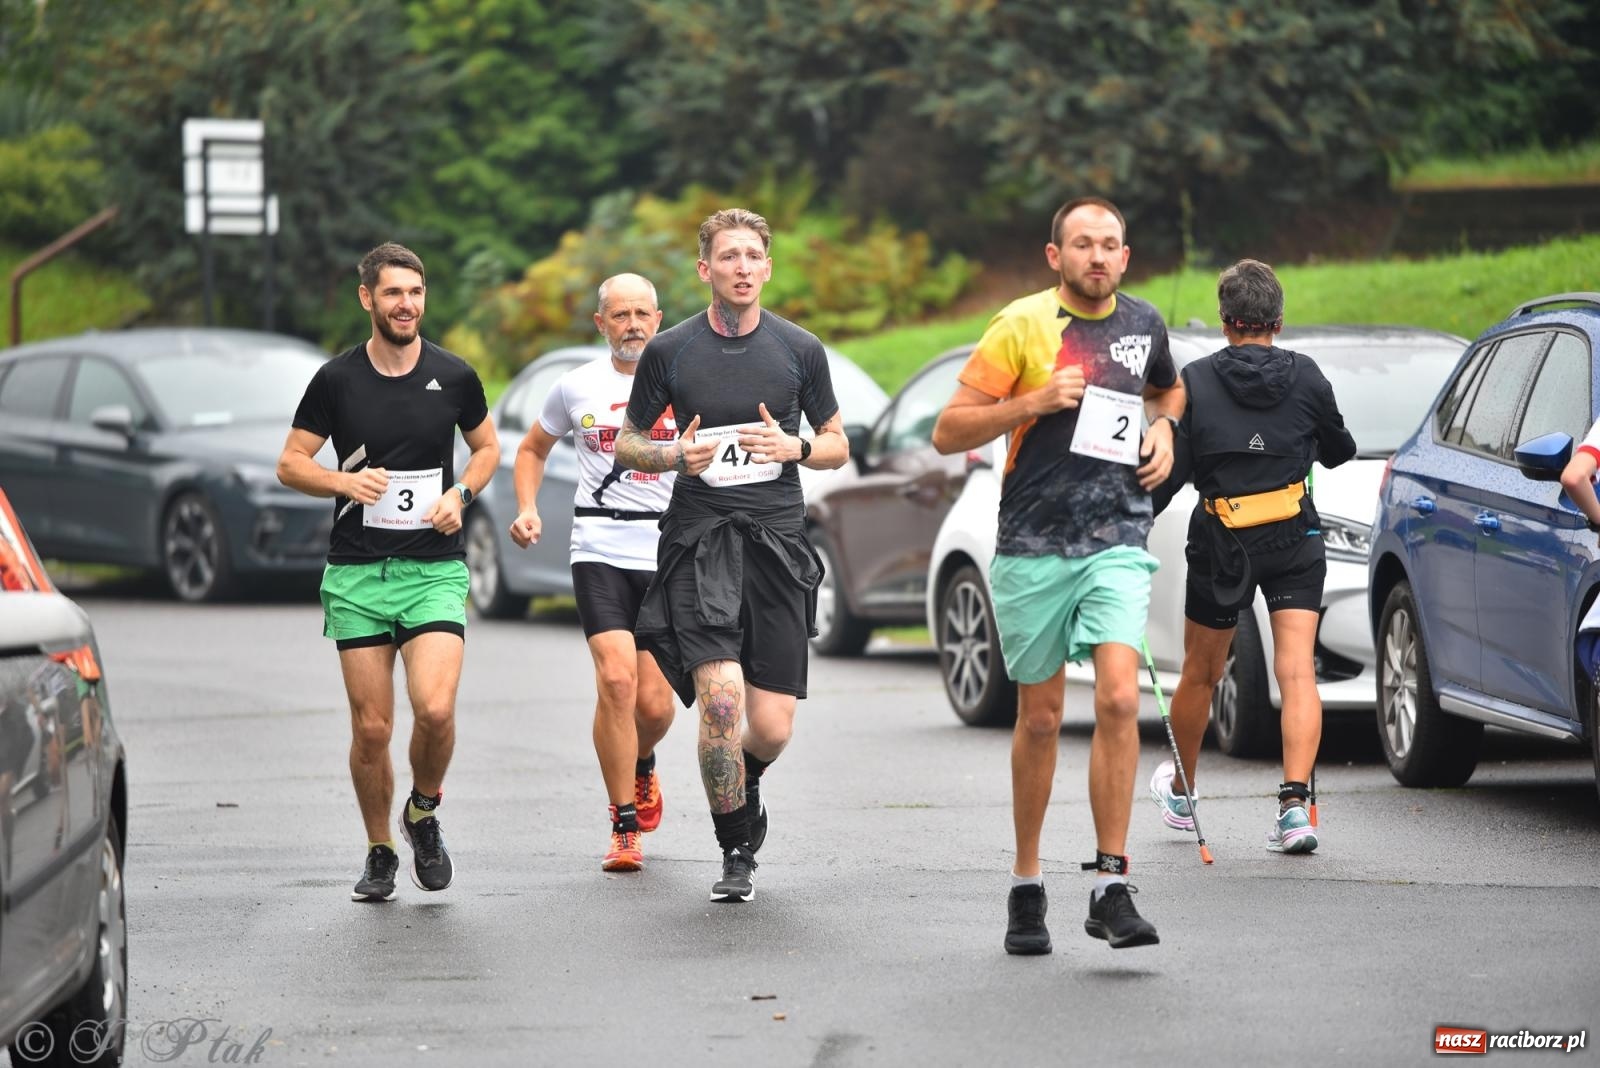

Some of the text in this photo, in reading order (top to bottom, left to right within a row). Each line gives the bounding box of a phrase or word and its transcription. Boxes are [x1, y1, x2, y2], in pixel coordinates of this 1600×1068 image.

[651, 430, 673, 440] BEZ
[1112, 416, 1129, 441] 2
[397, 489, 414, 512] 3
